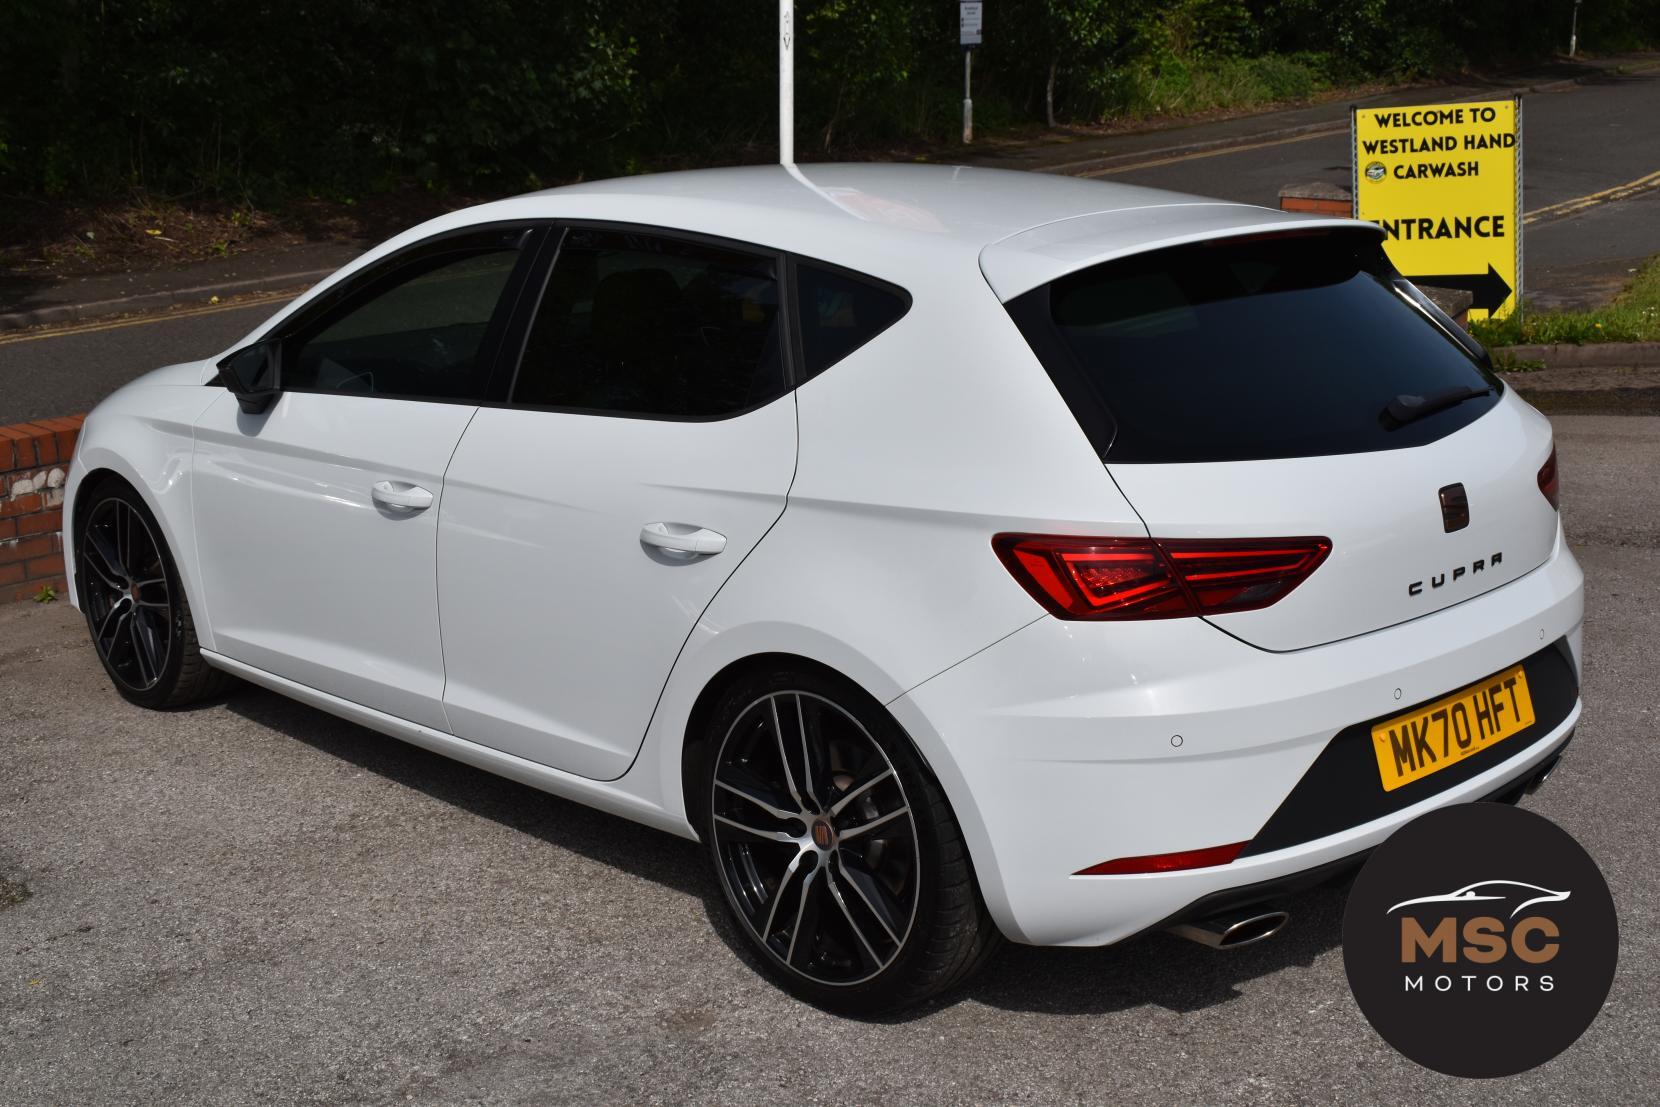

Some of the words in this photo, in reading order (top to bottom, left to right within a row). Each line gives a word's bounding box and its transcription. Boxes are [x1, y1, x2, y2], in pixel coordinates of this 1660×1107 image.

[1374, 109, 1464, 128] WELCOME
[1469, 107, 1496, 122] TO
[1362, 136, 1457, 154] WESTLAND
[1464, 133, 1516, 150] HAND
[1393, 161, 1479, 179] CARWASH
[1369, 215, 1505, 241] NTRANCE
[1408, 551, 1502, 596] CUPRA
[1389, 701, 1472, 778] MK70
[1473, 677, 1521, 741] HFT
